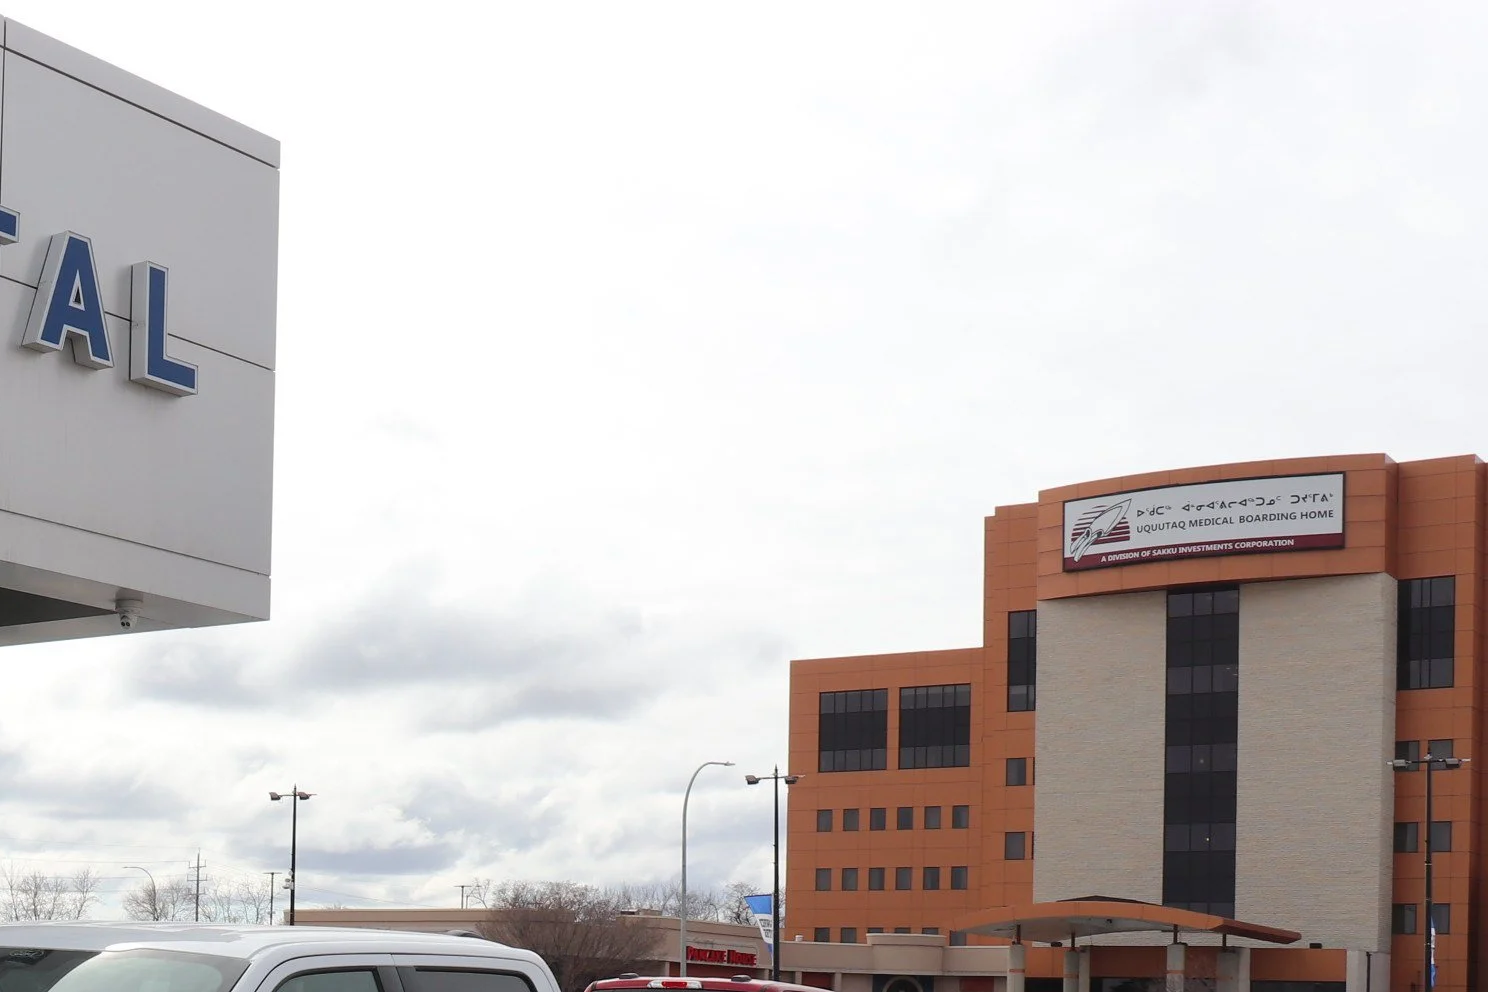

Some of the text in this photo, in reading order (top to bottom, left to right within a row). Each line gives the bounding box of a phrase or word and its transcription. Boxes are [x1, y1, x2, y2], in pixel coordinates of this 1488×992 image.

[1137, 510, 1334, 533] UQUUTAQ MEDICAL BOARDING HOME
[1108, 551, 1139, 562] DIVISION
[1141, 549, 1151, 557] OF
[1152, 547, 1177, 556] SAKKU
[1178, 542, 1233, 554] INVESTMENTS
[1234, 539, 1295, 549] CORPORATION
[686, 946, 757, 967] PANCAKE HOUSE
